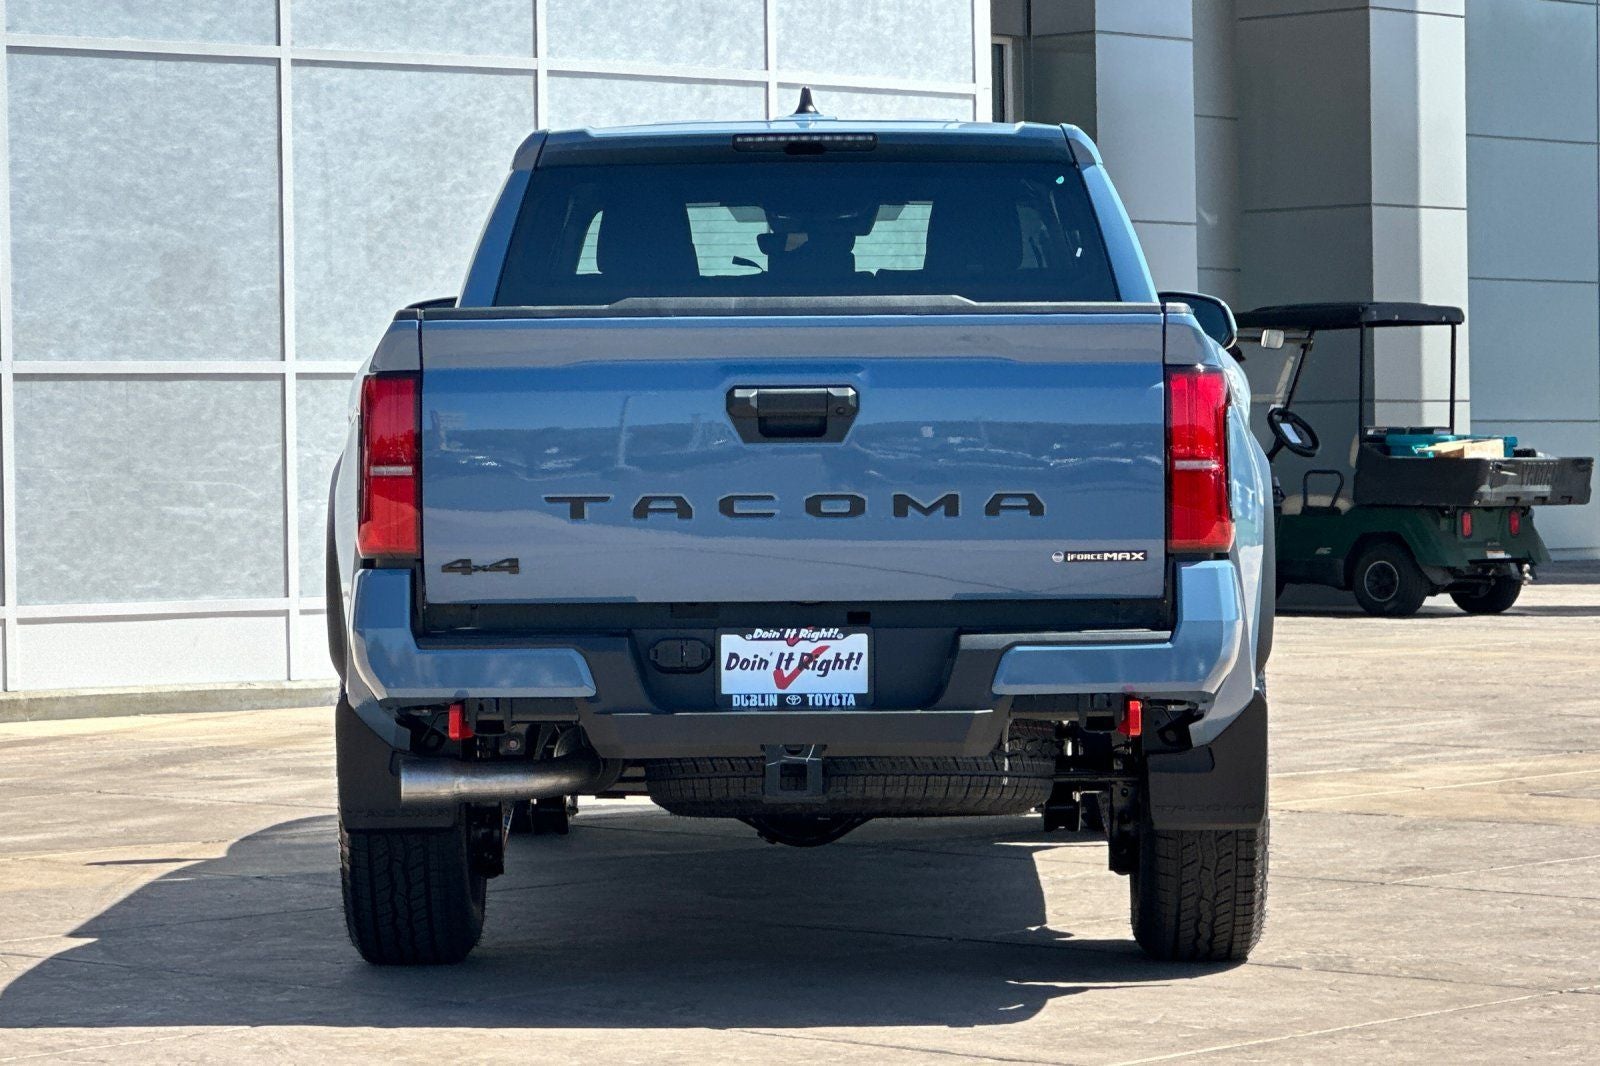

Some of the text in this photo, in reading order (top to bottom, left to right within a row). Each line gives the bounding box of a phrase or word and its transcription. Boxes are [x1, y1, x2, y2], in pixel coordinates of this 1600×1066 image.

[543, 492, 1046, 519] TACOMA
[441, 558, 519, 575] 4x4
[753, 628, 838, 641] Doin' It Right!
[725, 651, 864, 678] Doin' It Right!
[732, 694, 856, 707] DUBLIN TOYOTA
